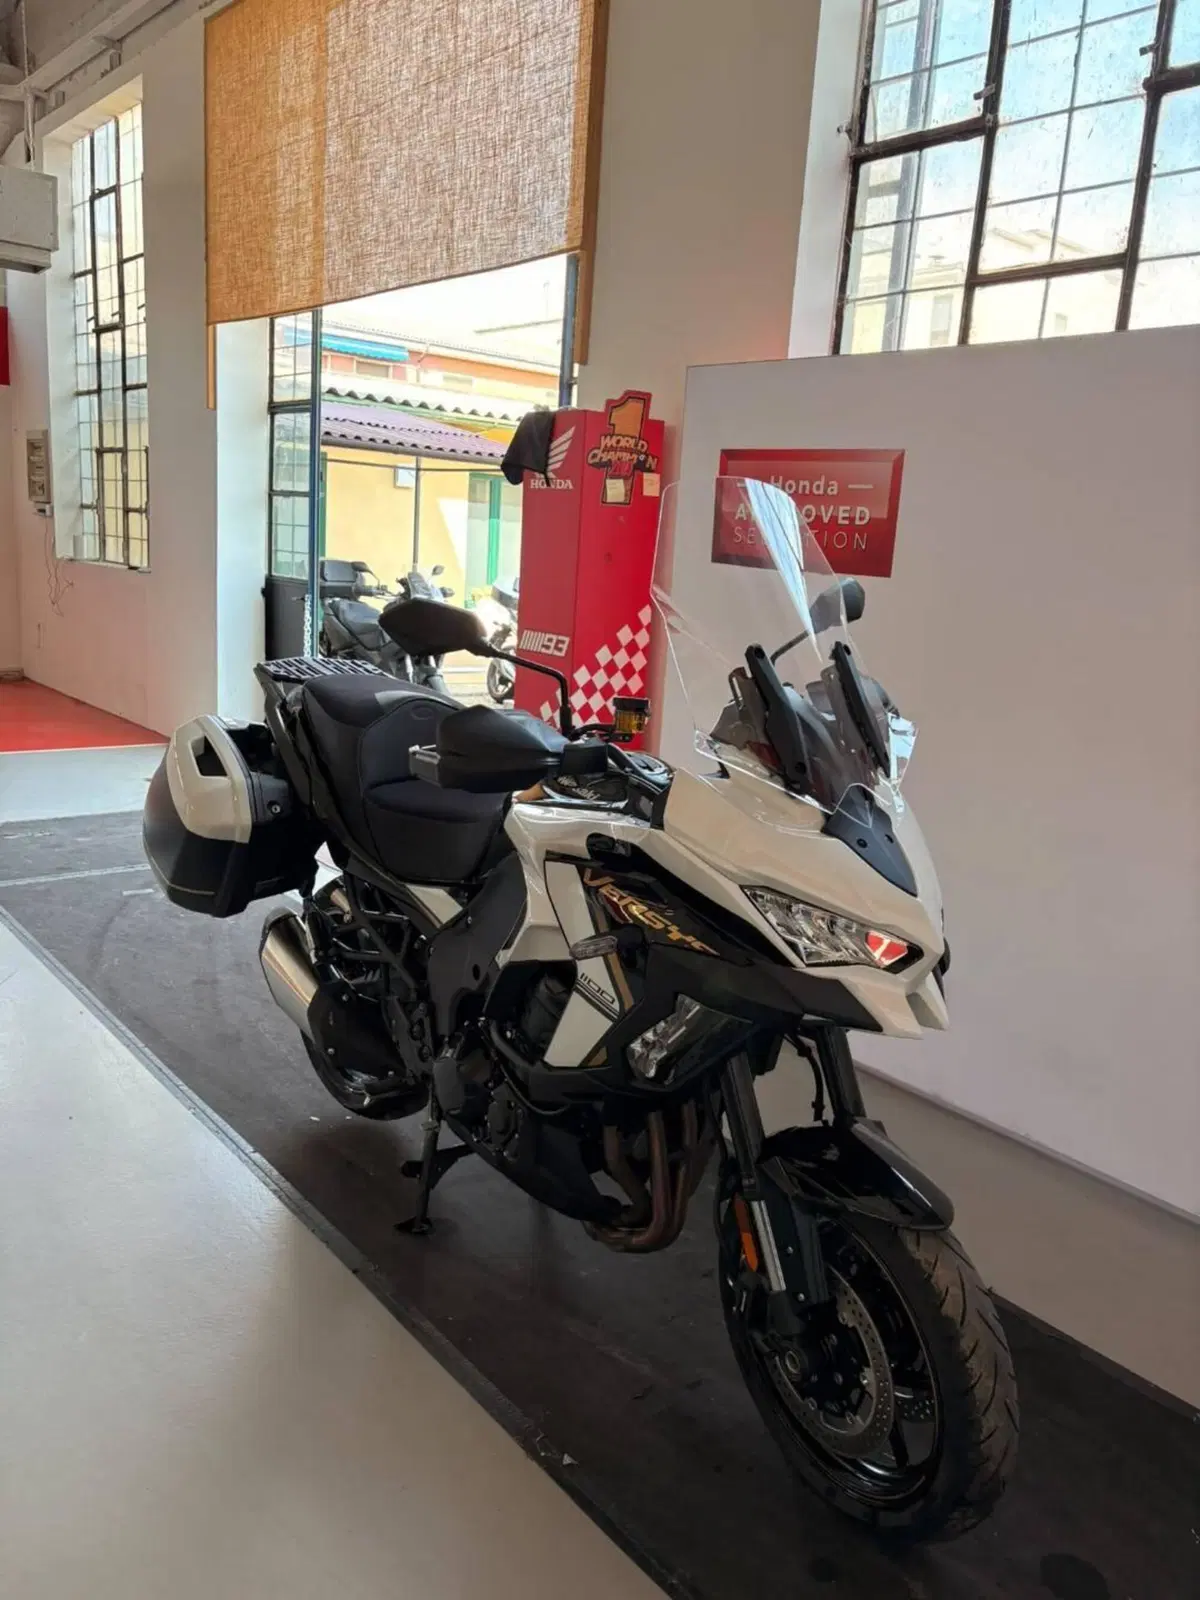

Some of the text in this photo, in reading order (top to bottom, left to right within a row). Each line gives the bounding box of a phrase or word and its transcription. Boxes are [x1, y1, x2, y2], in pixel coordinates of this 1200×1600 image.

[600, 435, 648, 453] WORLD
[769, 475, 839, 496] Honda
[735, 502, 870, 525] AOVED
[733, 526, 868, 550] SETION
[540, 633, 571, 657] 93
[579, 972, 616, 1005] 1100
